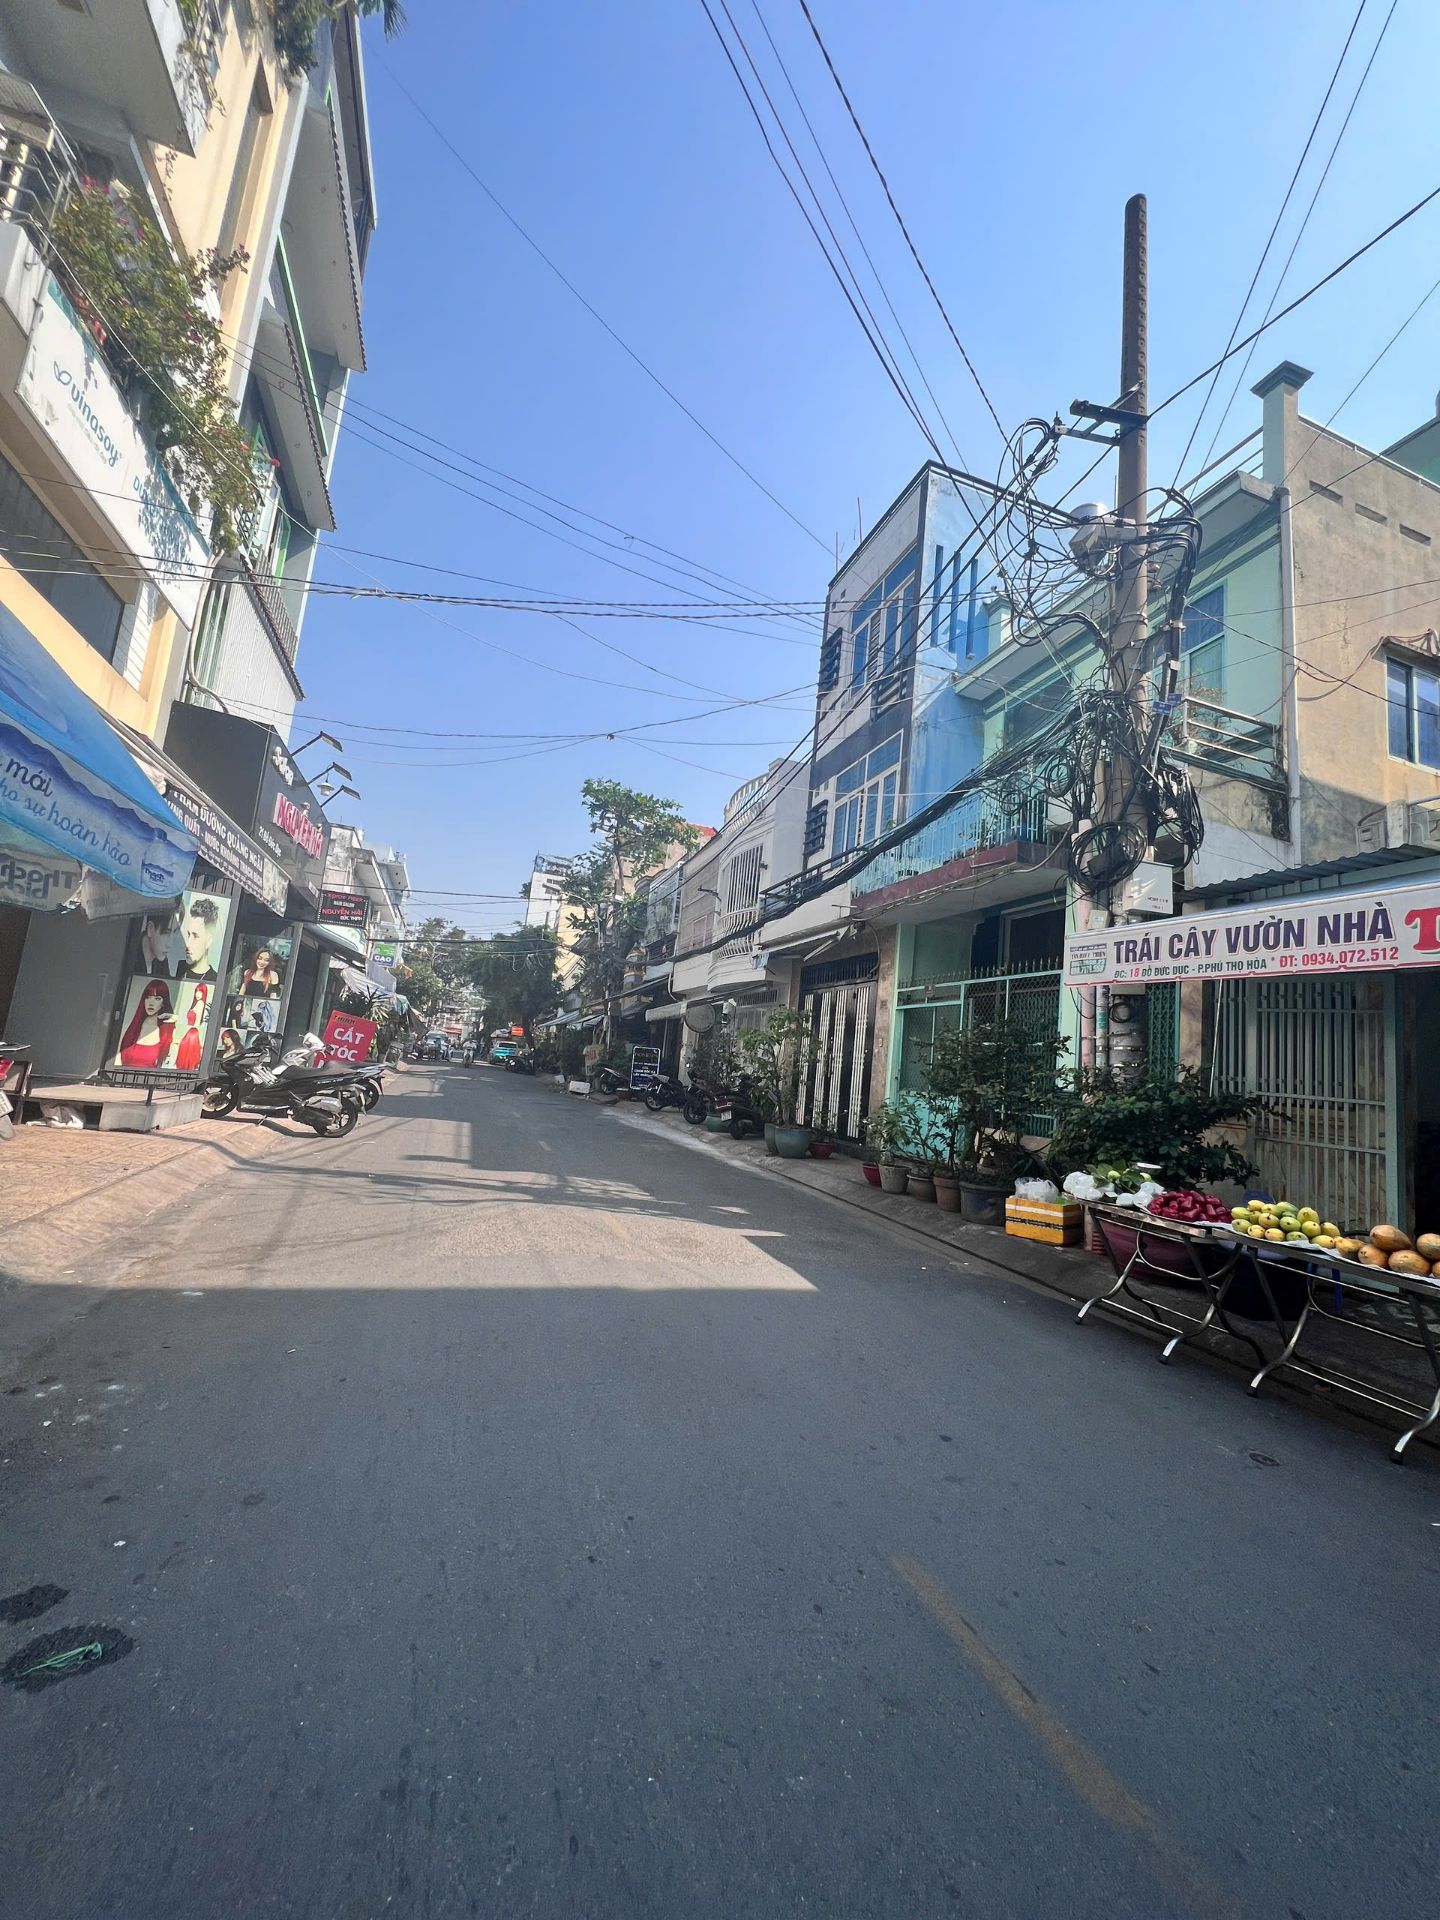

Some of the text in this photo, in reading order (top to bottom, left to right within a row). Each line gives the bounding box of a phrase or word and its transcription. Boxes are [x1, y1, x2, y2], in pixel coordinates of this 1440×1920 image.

[71, 390, 118, 467] vinasoy
[6, 758, 52, 797] mới
[48, 801, 99, 847] hoàn
[1113, 931, 1161, 964] TRÁI
[1168, 926, 1217, 959] CÂY
[1225, 915, 1305, 954] VƯỜN
[1317, 901, 1394, 946] NHÀ
[1279, 946, 1399, 968] ĐT: 0934.072.512
[1130, 967, 1140, 978] 18
[334, 1027, 364, 1045] CẮT
[329, 1044, 358, 1062] TÓC
